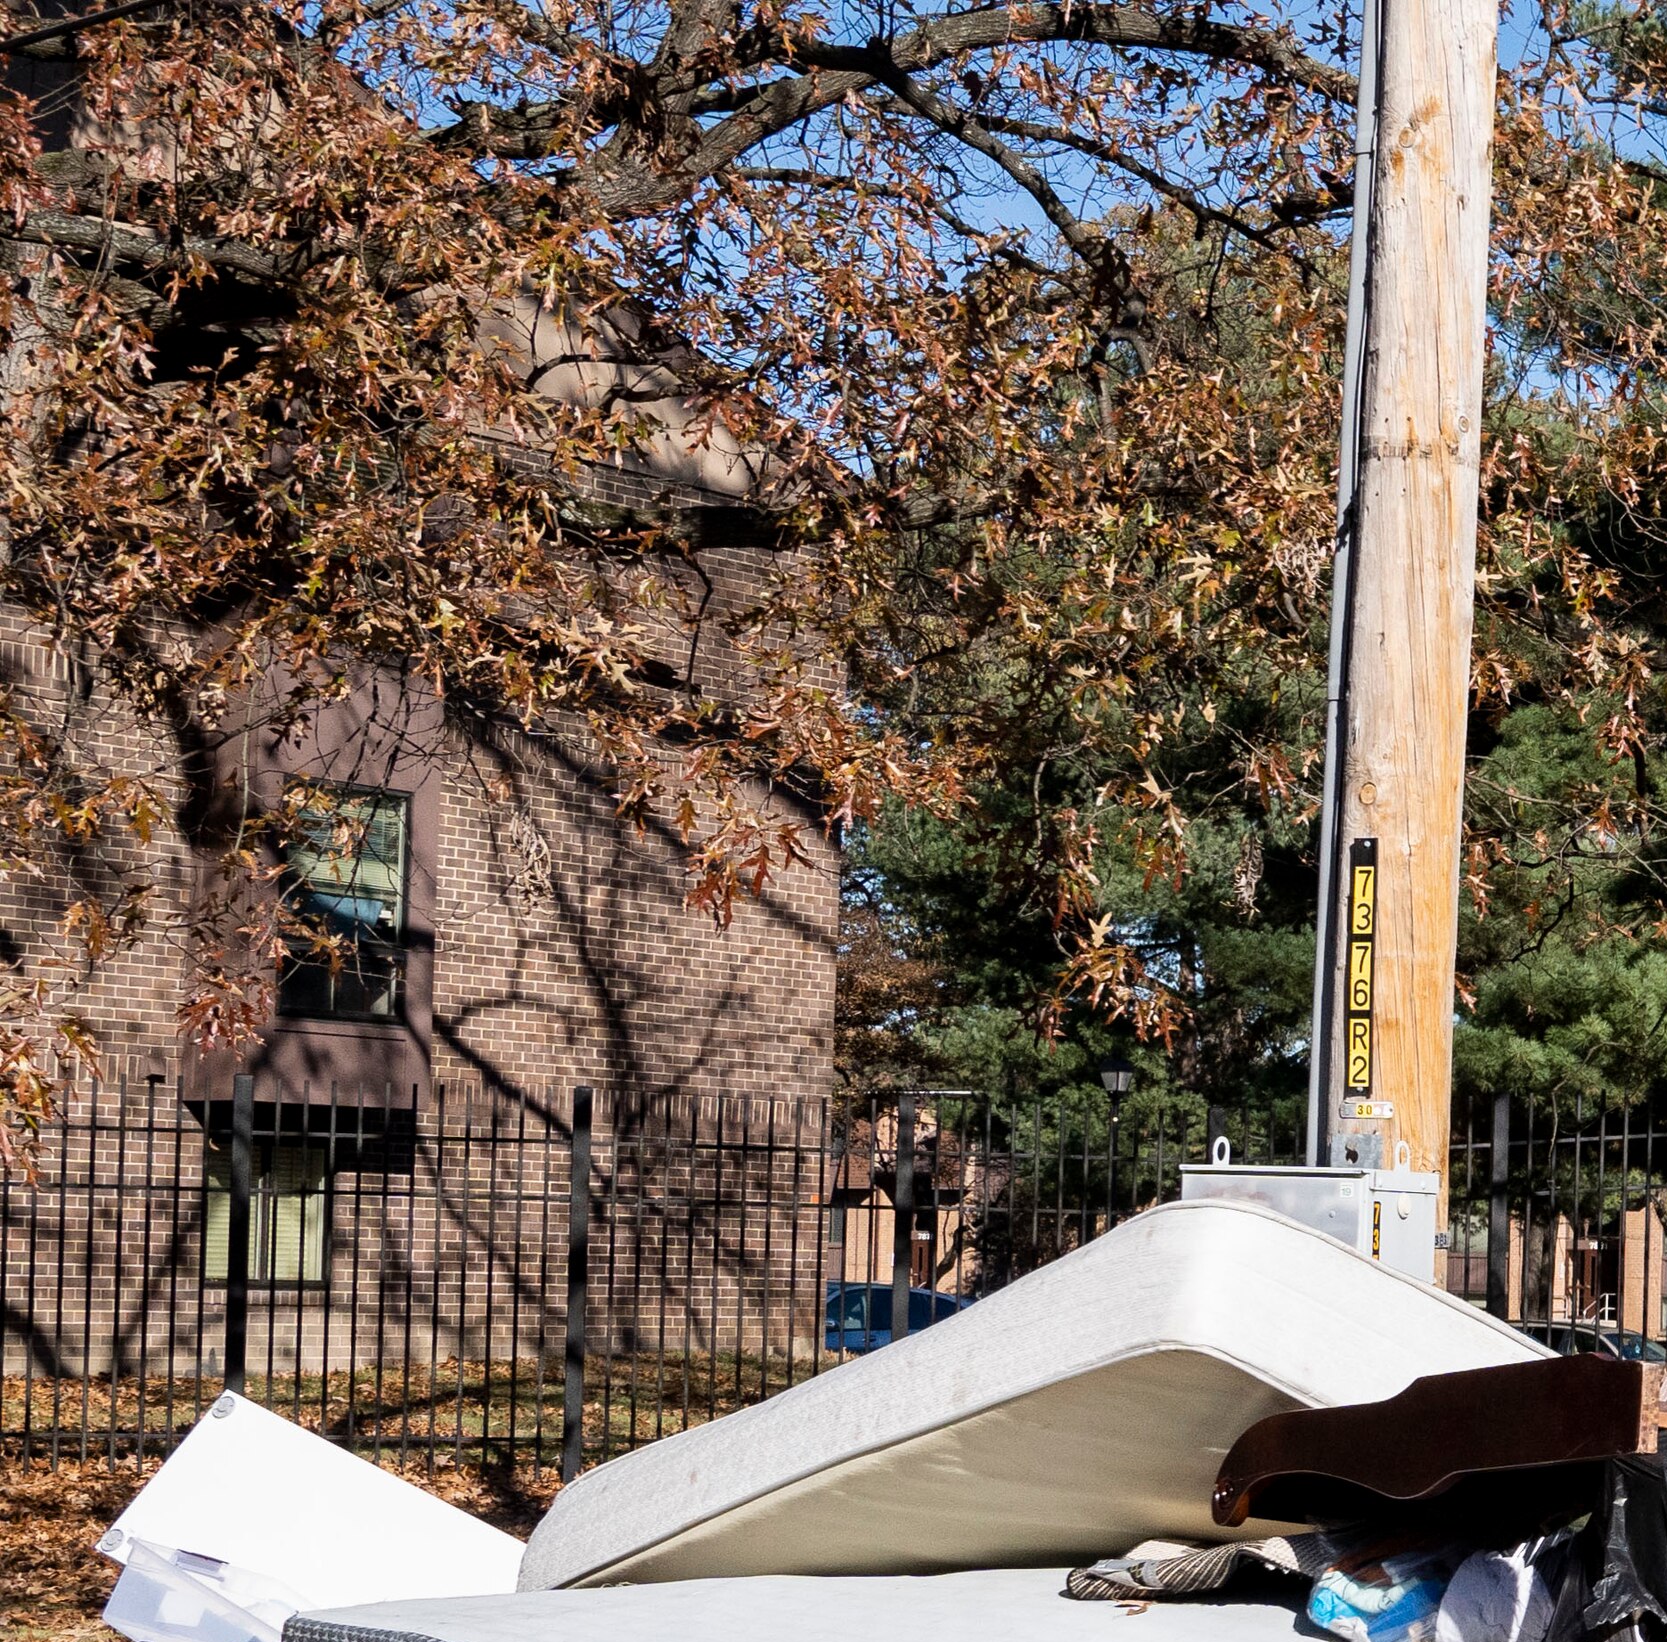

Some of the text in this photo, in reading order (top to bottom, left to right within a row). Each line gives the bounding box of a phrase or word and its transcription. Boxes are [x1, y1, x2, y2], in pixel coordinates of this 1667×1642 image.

[1351, 869, 1373, 1085] 73 76 R2
[1357, 1104, 1373, 1116] 30
